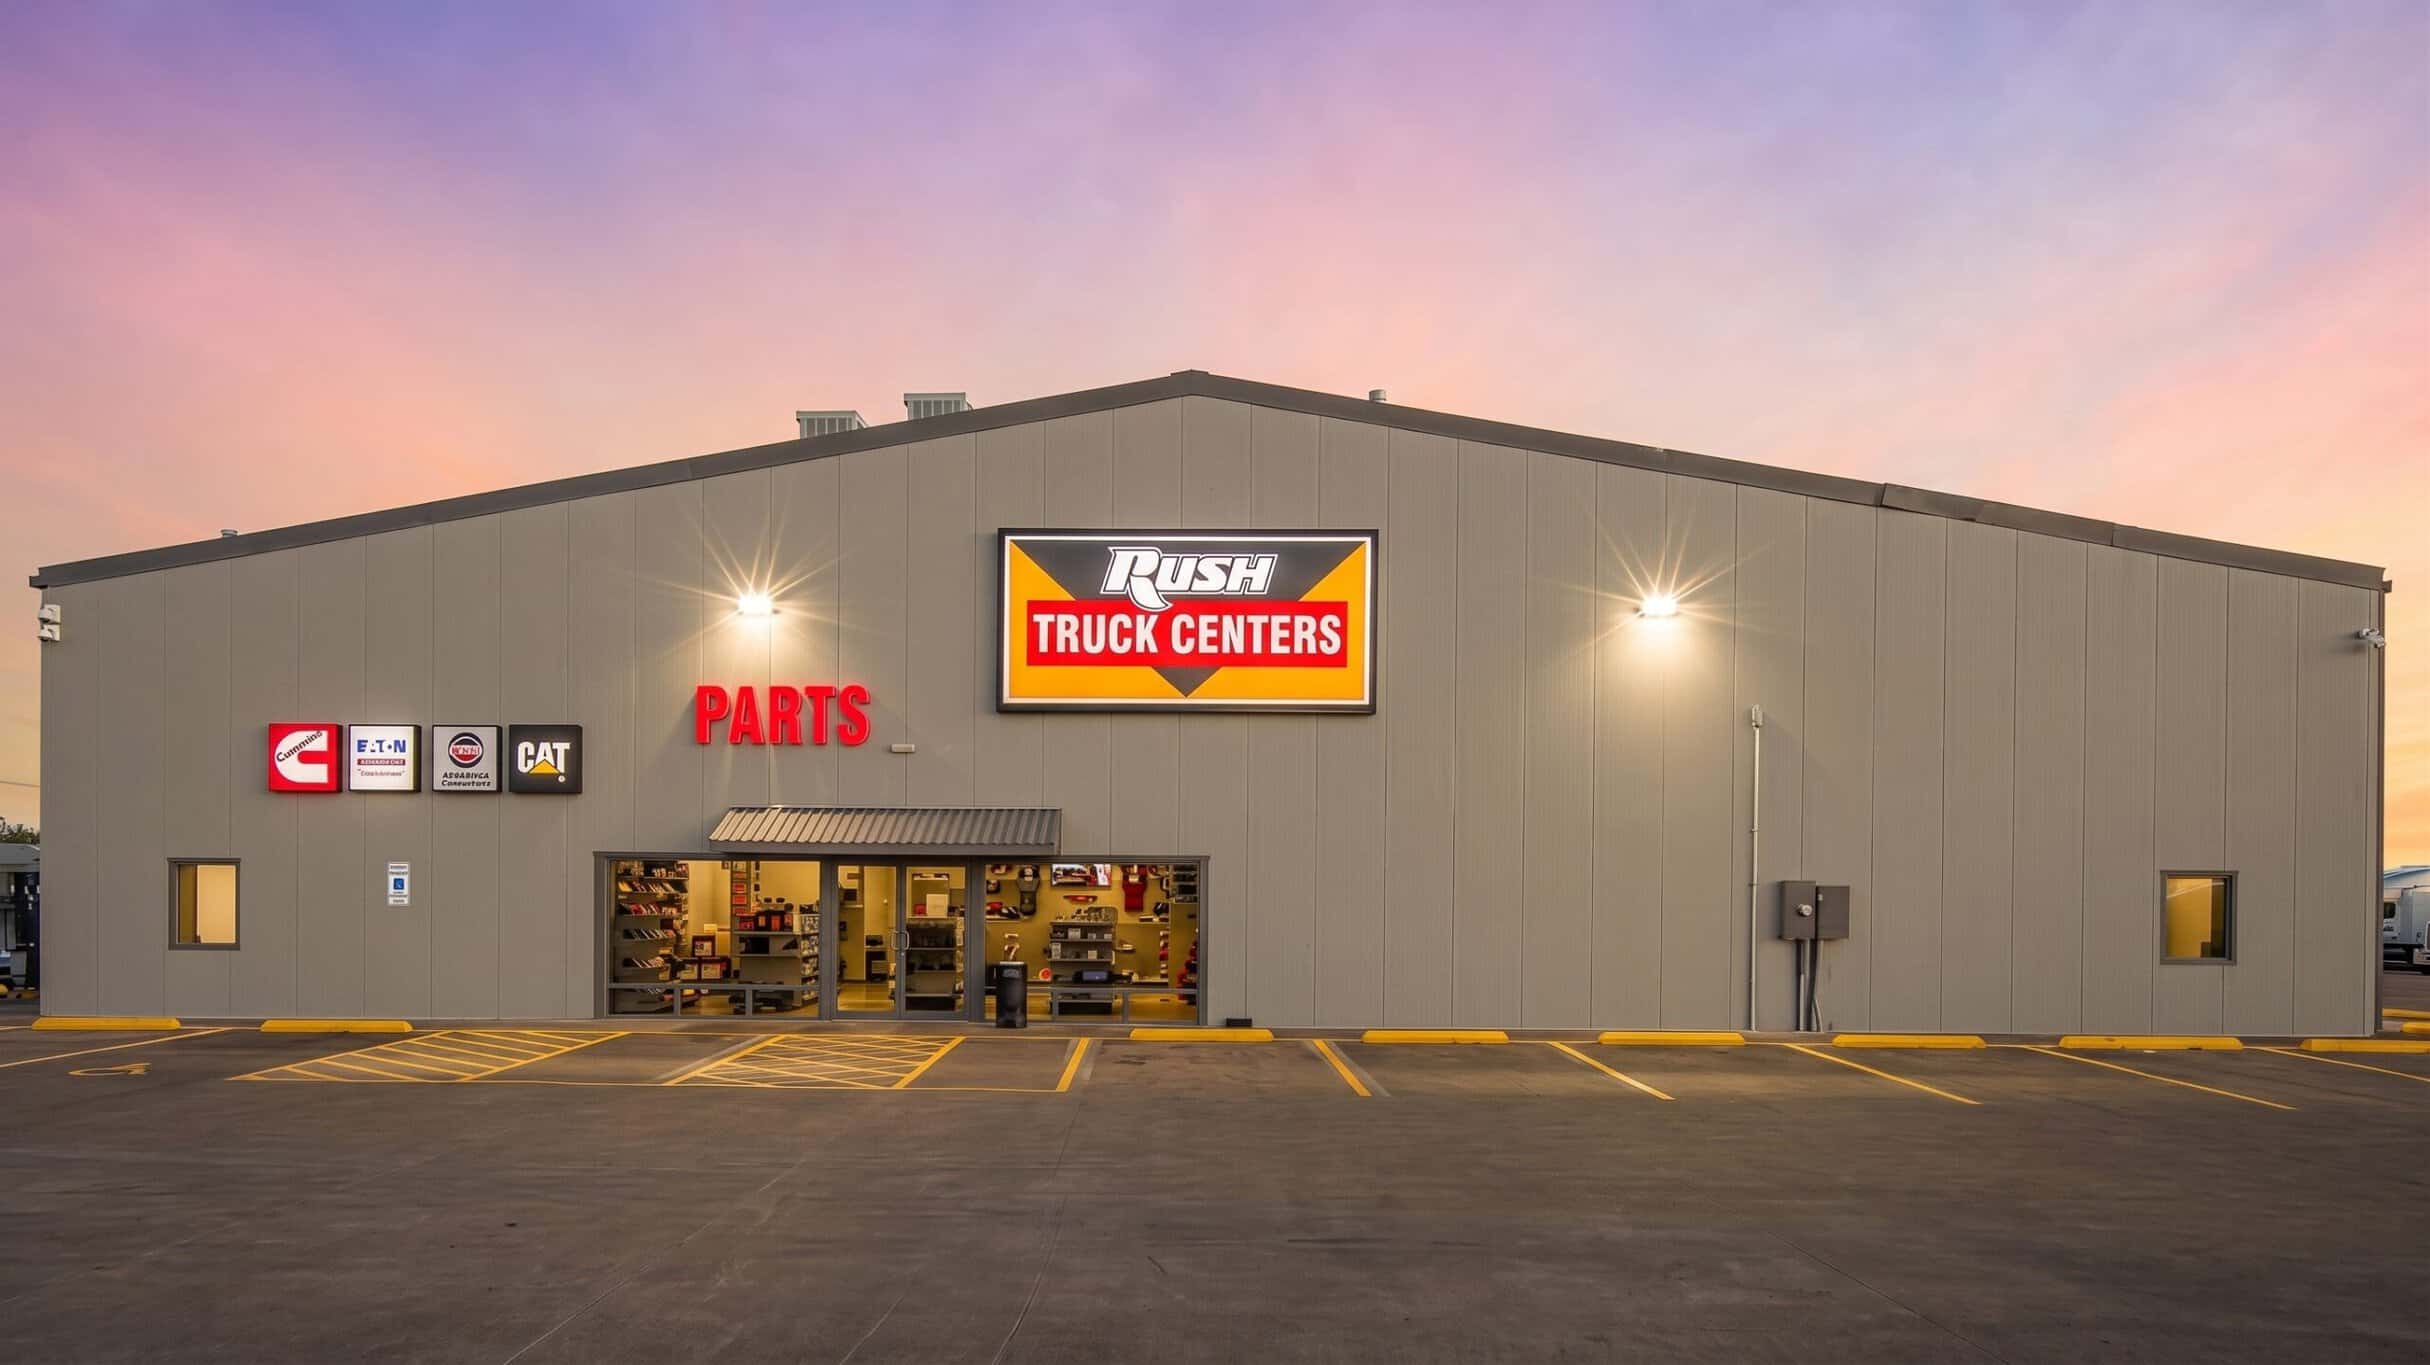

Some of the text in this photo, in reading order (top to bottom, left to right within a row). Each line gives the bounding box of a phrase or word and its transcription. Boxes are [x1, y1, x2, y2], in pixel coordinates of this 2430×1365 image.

[1100, 546, 1278, 612] RUSH
[1033, 614, 1342, 655] TRUCK CENTERS
[696, 685, 870, 746] PARTS
[518, 741, 571, 773] CAT
